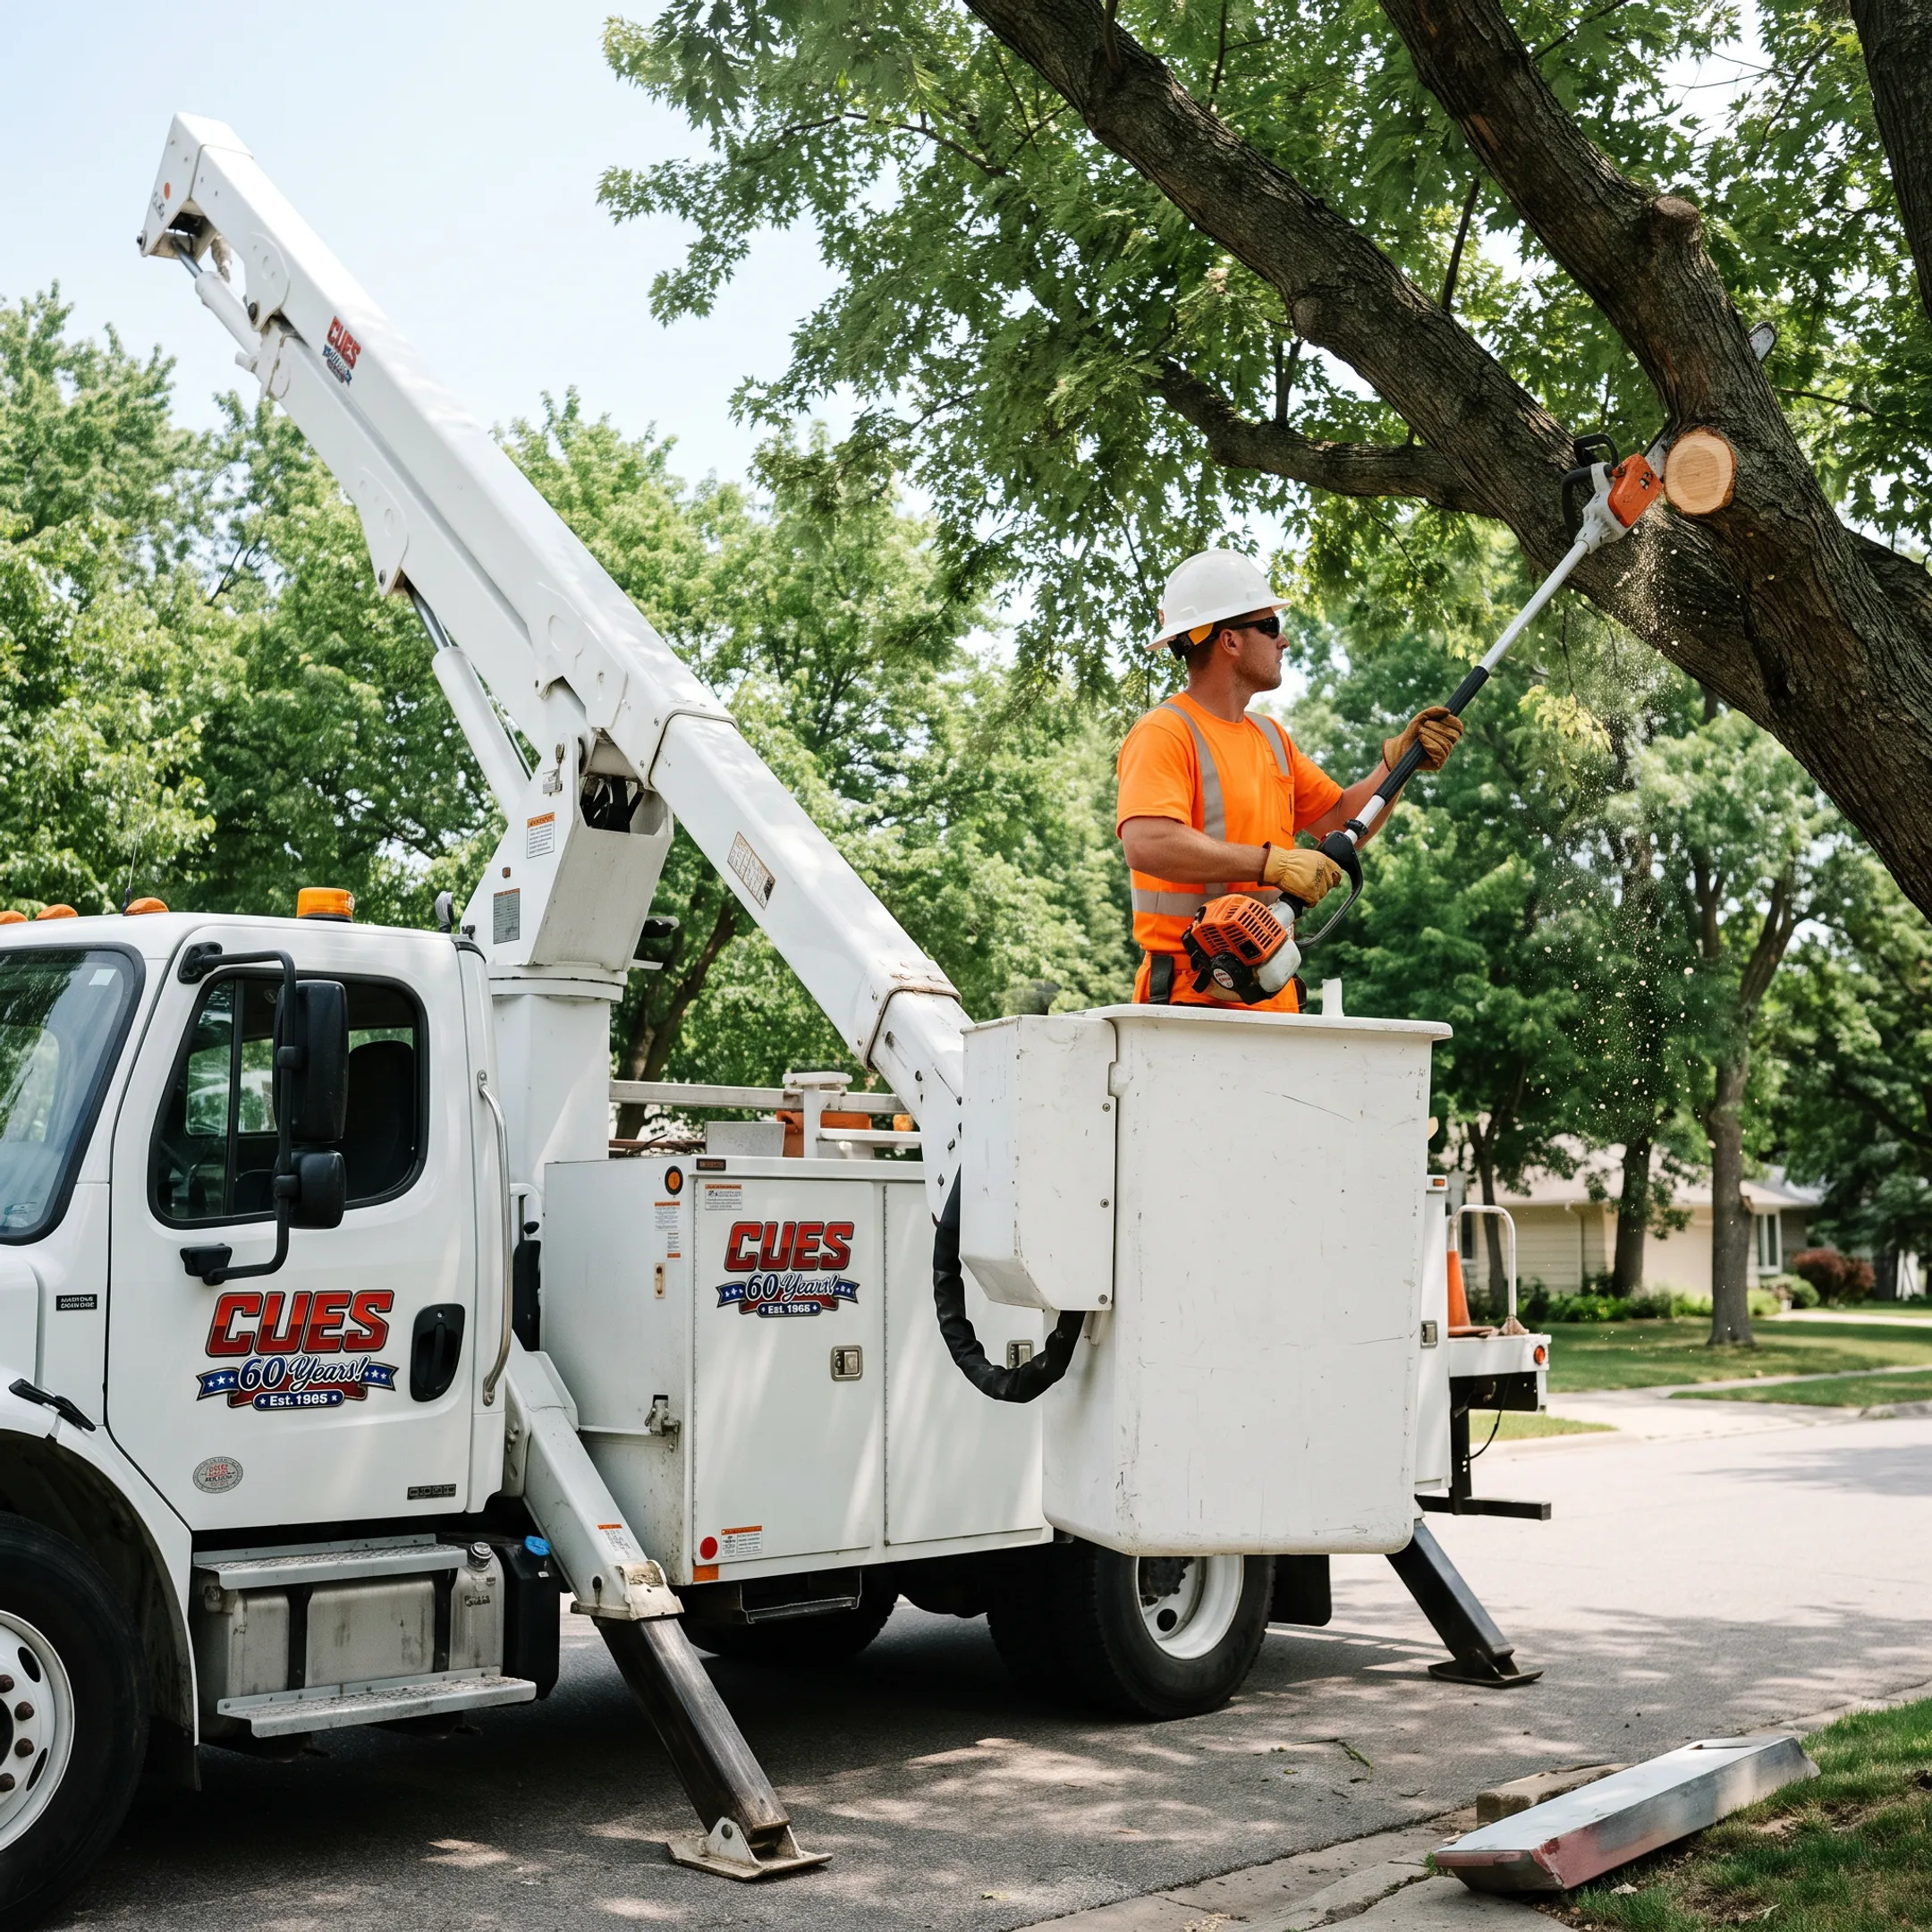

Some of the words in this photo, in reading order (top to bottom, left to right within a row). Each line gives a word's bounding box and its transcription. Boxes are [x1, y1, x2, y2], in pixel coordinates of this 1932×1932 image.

[327, 316, 361, 369] CUES
[724, 1221, 854, 1272] CUES
[745, 1273, 780, 1301] 60
[205, 1290, 394, 1357] CUES
[238, 1355, 287, 1392] 60
[287, 1355, 371, 1394] Years!
[269, 1395, 293, 1406] Est.
